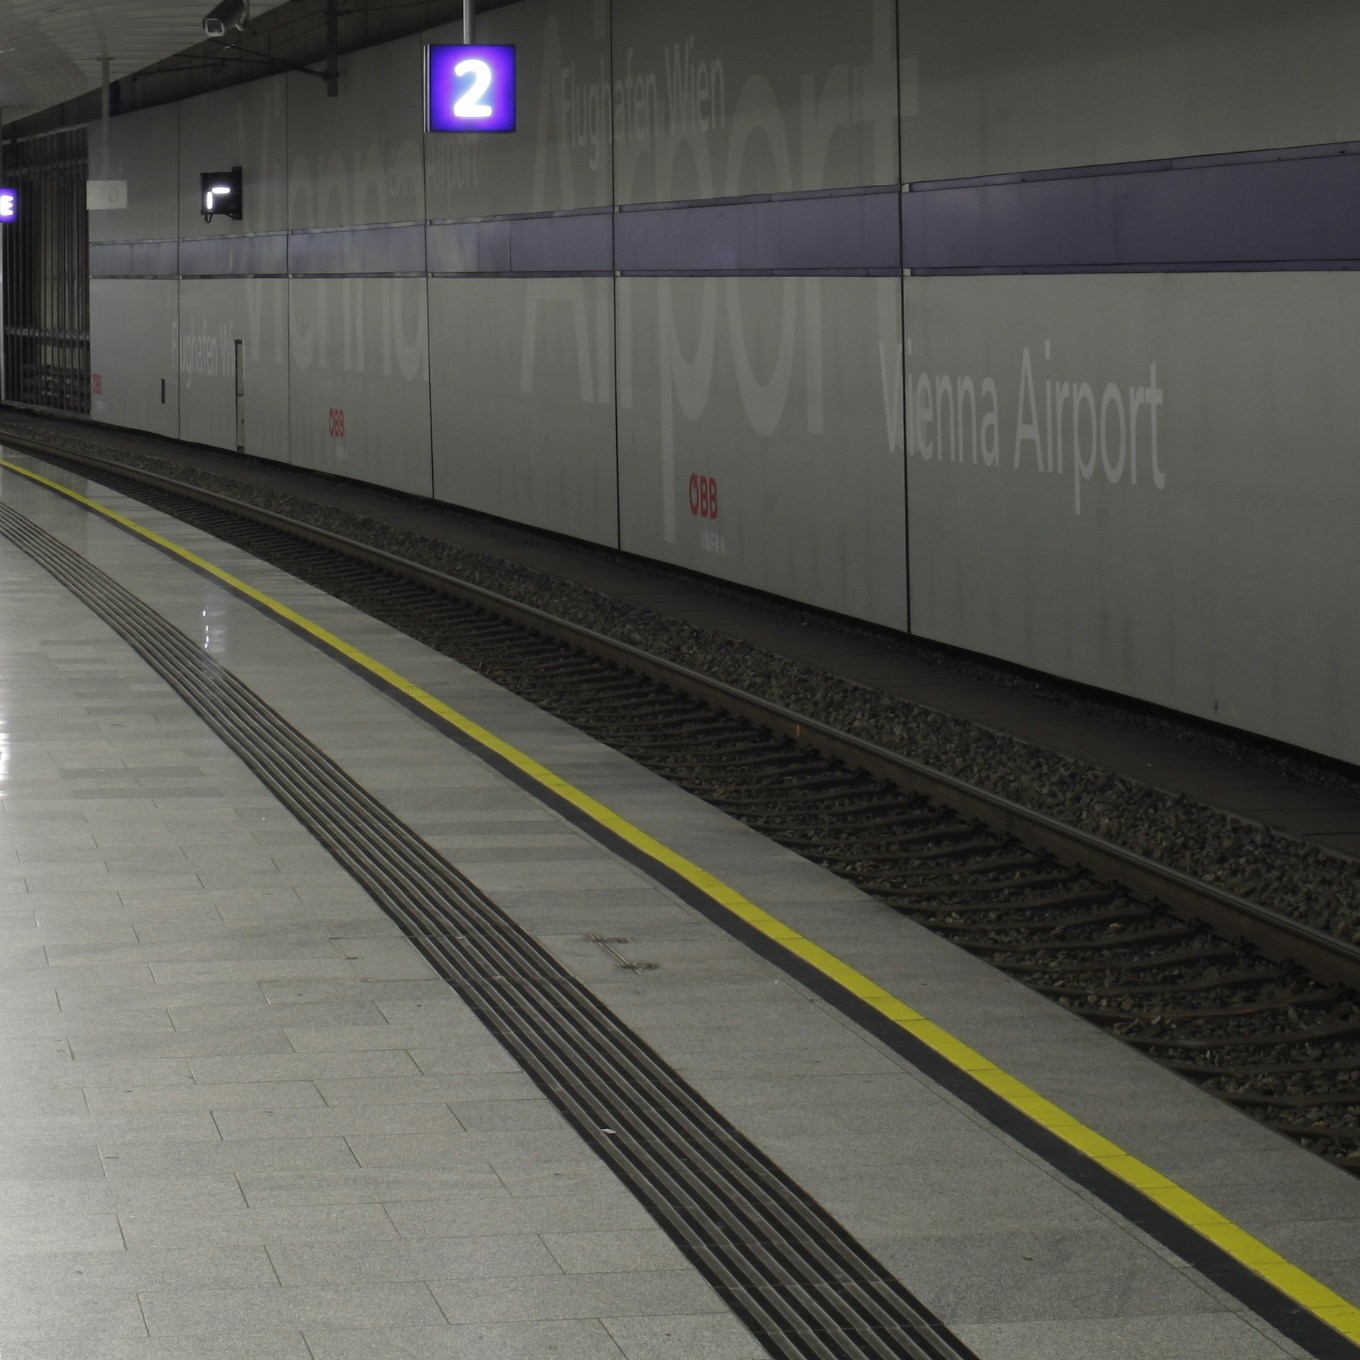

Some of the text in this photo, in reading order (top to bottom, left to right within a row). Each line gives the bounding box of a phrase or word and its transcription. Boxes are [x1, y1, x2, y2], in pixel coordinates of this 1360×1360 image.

[453, 59, 493, 117] 2
[559, 45, 658, 171] Flughafen
[663, 34, 726, 137] Wien
[879, 338, 1166, 515] Vienna Airport
[689, 473, 718, 520] ÖBB
